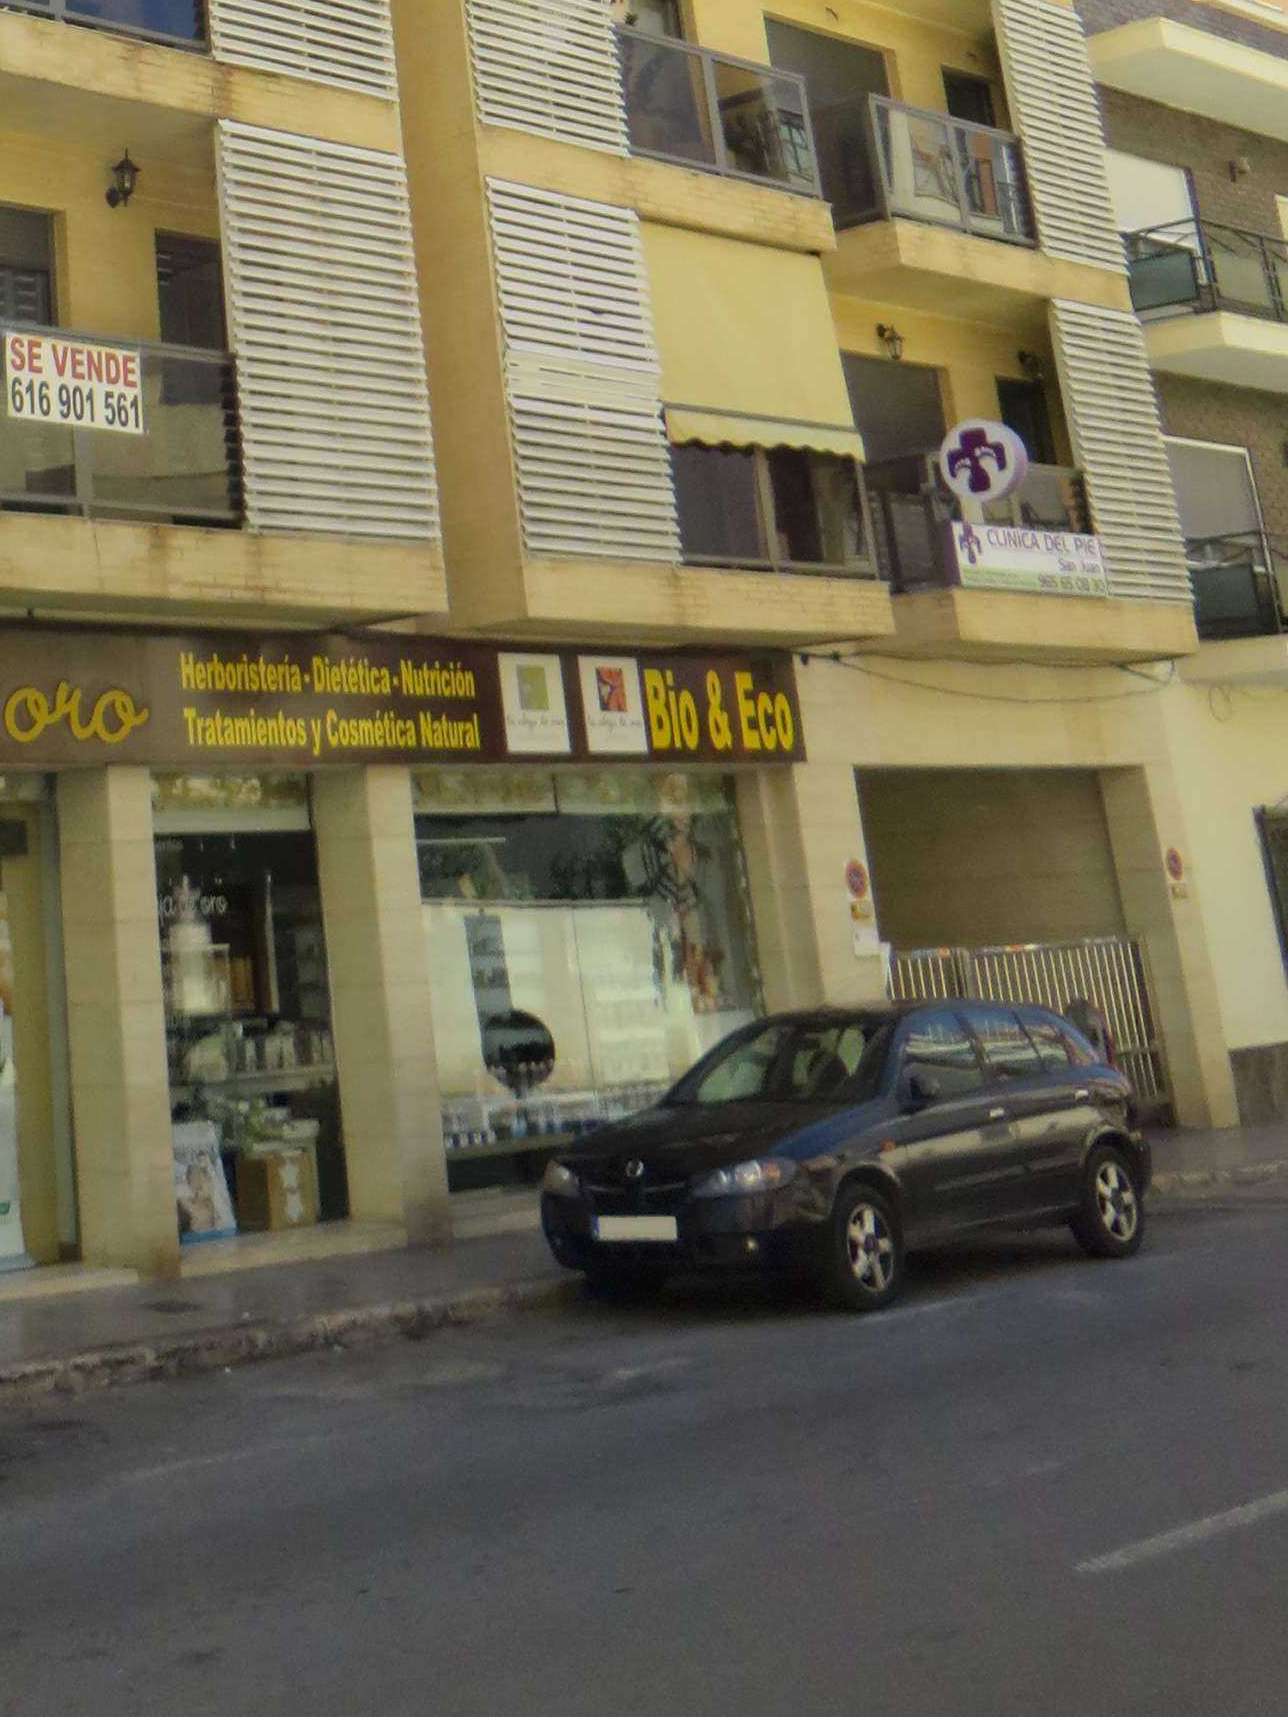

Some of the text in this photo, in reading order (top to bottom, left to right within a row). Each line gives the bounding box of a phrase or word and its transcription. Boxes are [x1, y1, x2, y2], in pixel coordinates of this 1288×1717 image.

[10, 336, 138, 388] SE VENDE
[11, 377, 140, 428] 616 901 561
[1044, 532, 1071, 553] DEL
[1073, 535, 1096, 556] PIE
[180, 650, 302, 692] Herboristería
[312, 655, 391, 695] Dietética
[400, 659, 476, 699] Nutrición
[4, 681, 149, 744] oro
[183, 706, 481, 756] Tratamientos y Cosmética Natural
[643, 668, 794, 751] Bio & Eco
